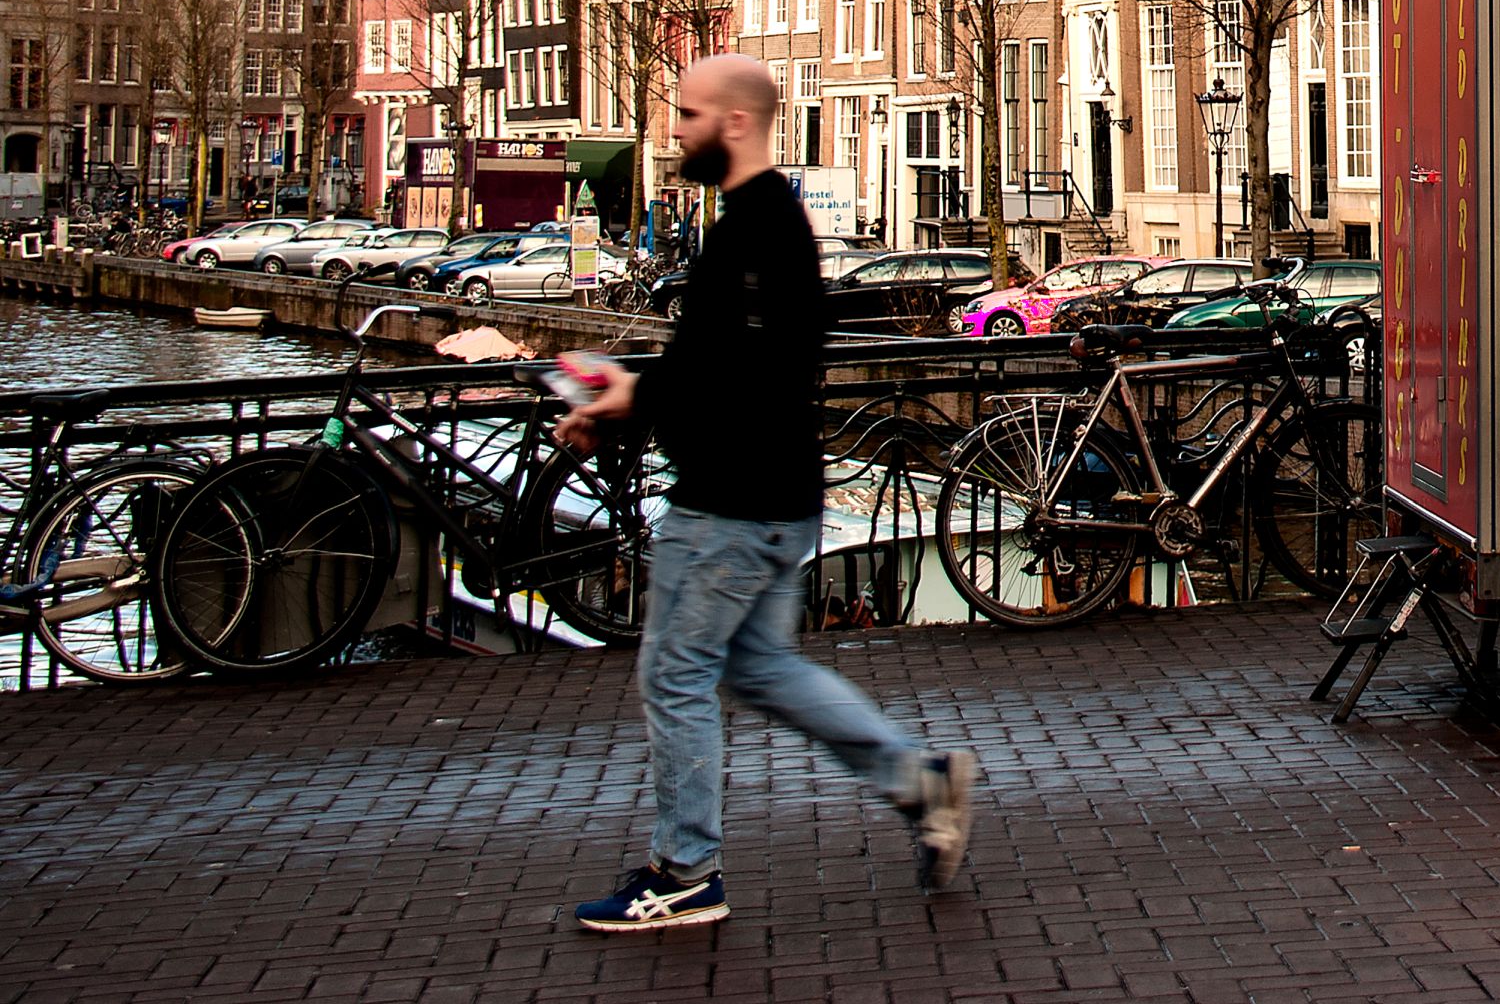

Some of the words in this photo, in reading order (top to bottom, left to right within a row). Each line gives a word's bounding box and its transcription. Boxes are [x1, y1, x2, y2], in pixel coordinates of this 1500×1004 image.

[803, 190, 834, 199] Bestel
[809, 201, 825, 209] via
[827, 200, 851, 210] ah.nl
[1456, 136, 1470, 487] DRINKS
